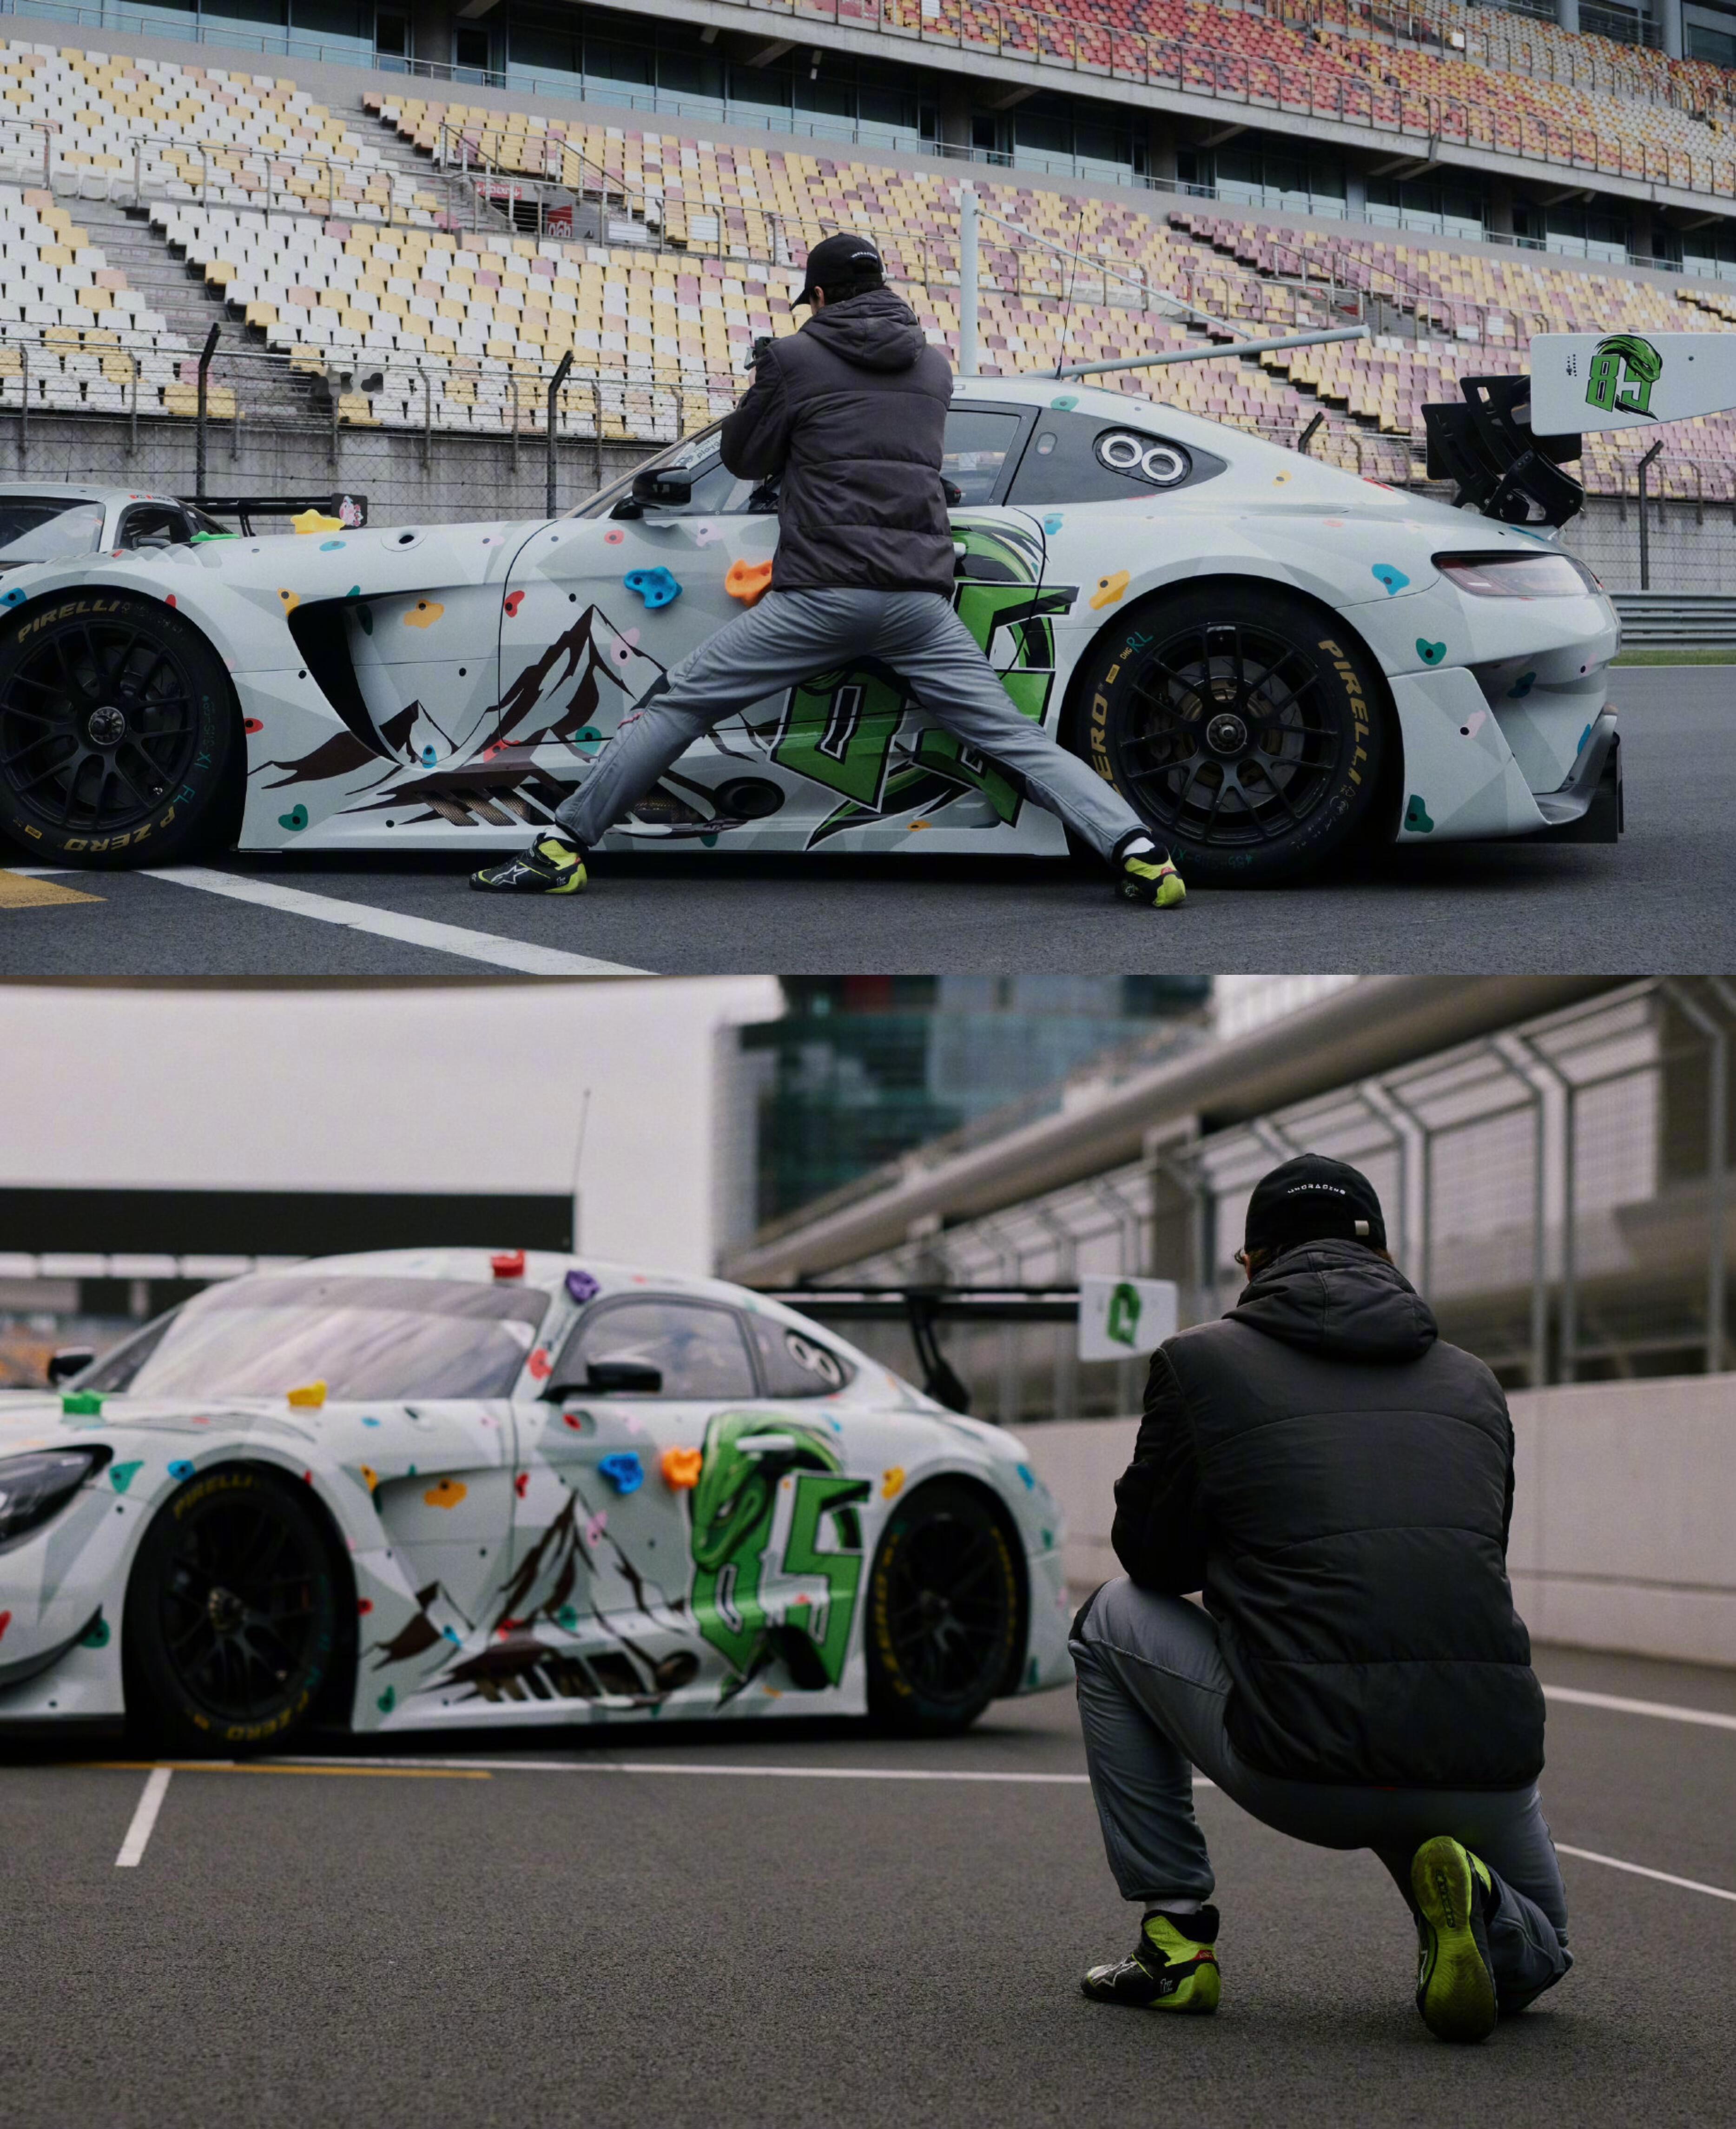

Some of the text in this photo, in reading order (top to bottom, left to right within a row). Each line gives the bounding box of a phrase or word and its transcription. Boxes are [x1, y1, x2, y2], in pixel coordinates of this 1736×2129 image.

[18, 599, 121, 644] PIRELLI
[1126, 631, 1155, 654] RL
[1318, 640, 1370, 786] PIRELLI
[1091, 692, 1122, 798] ERO
[173, 784, 197, 804] FL
[159, 806, 175, 828] P
[63, 823, 152, 852] ZERO
